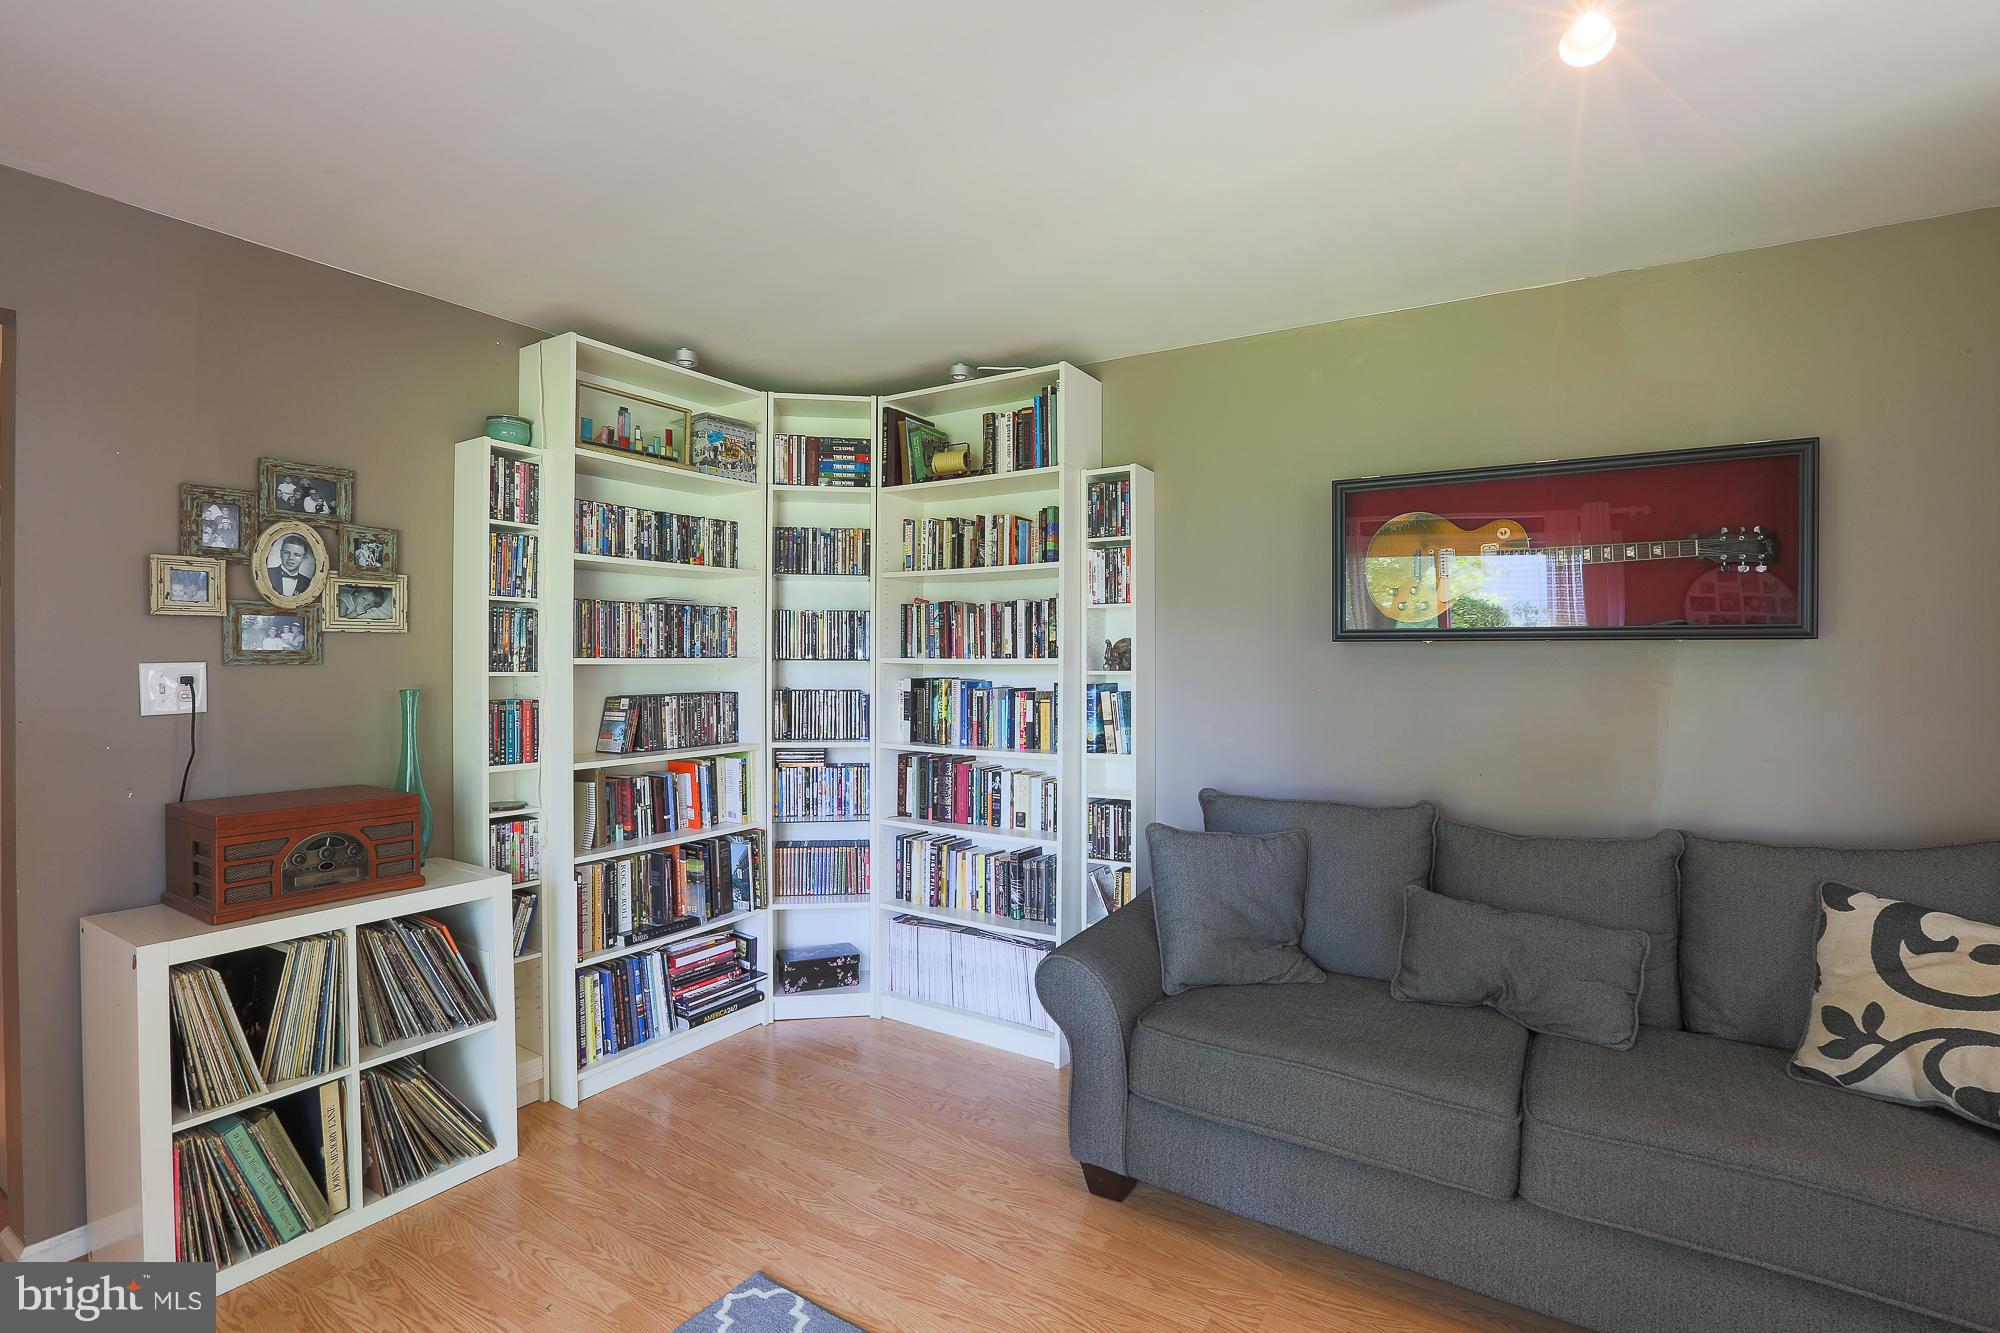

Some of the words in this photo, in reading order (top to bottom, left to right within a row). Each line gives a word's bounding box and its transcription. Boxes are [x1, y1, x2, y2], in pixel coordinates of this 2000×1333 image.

[327, 1104, 336, 1129] LANE
[329, 1130, 339, 1165] MEMORY
[332, 1166, 341, 1193] DOWN
